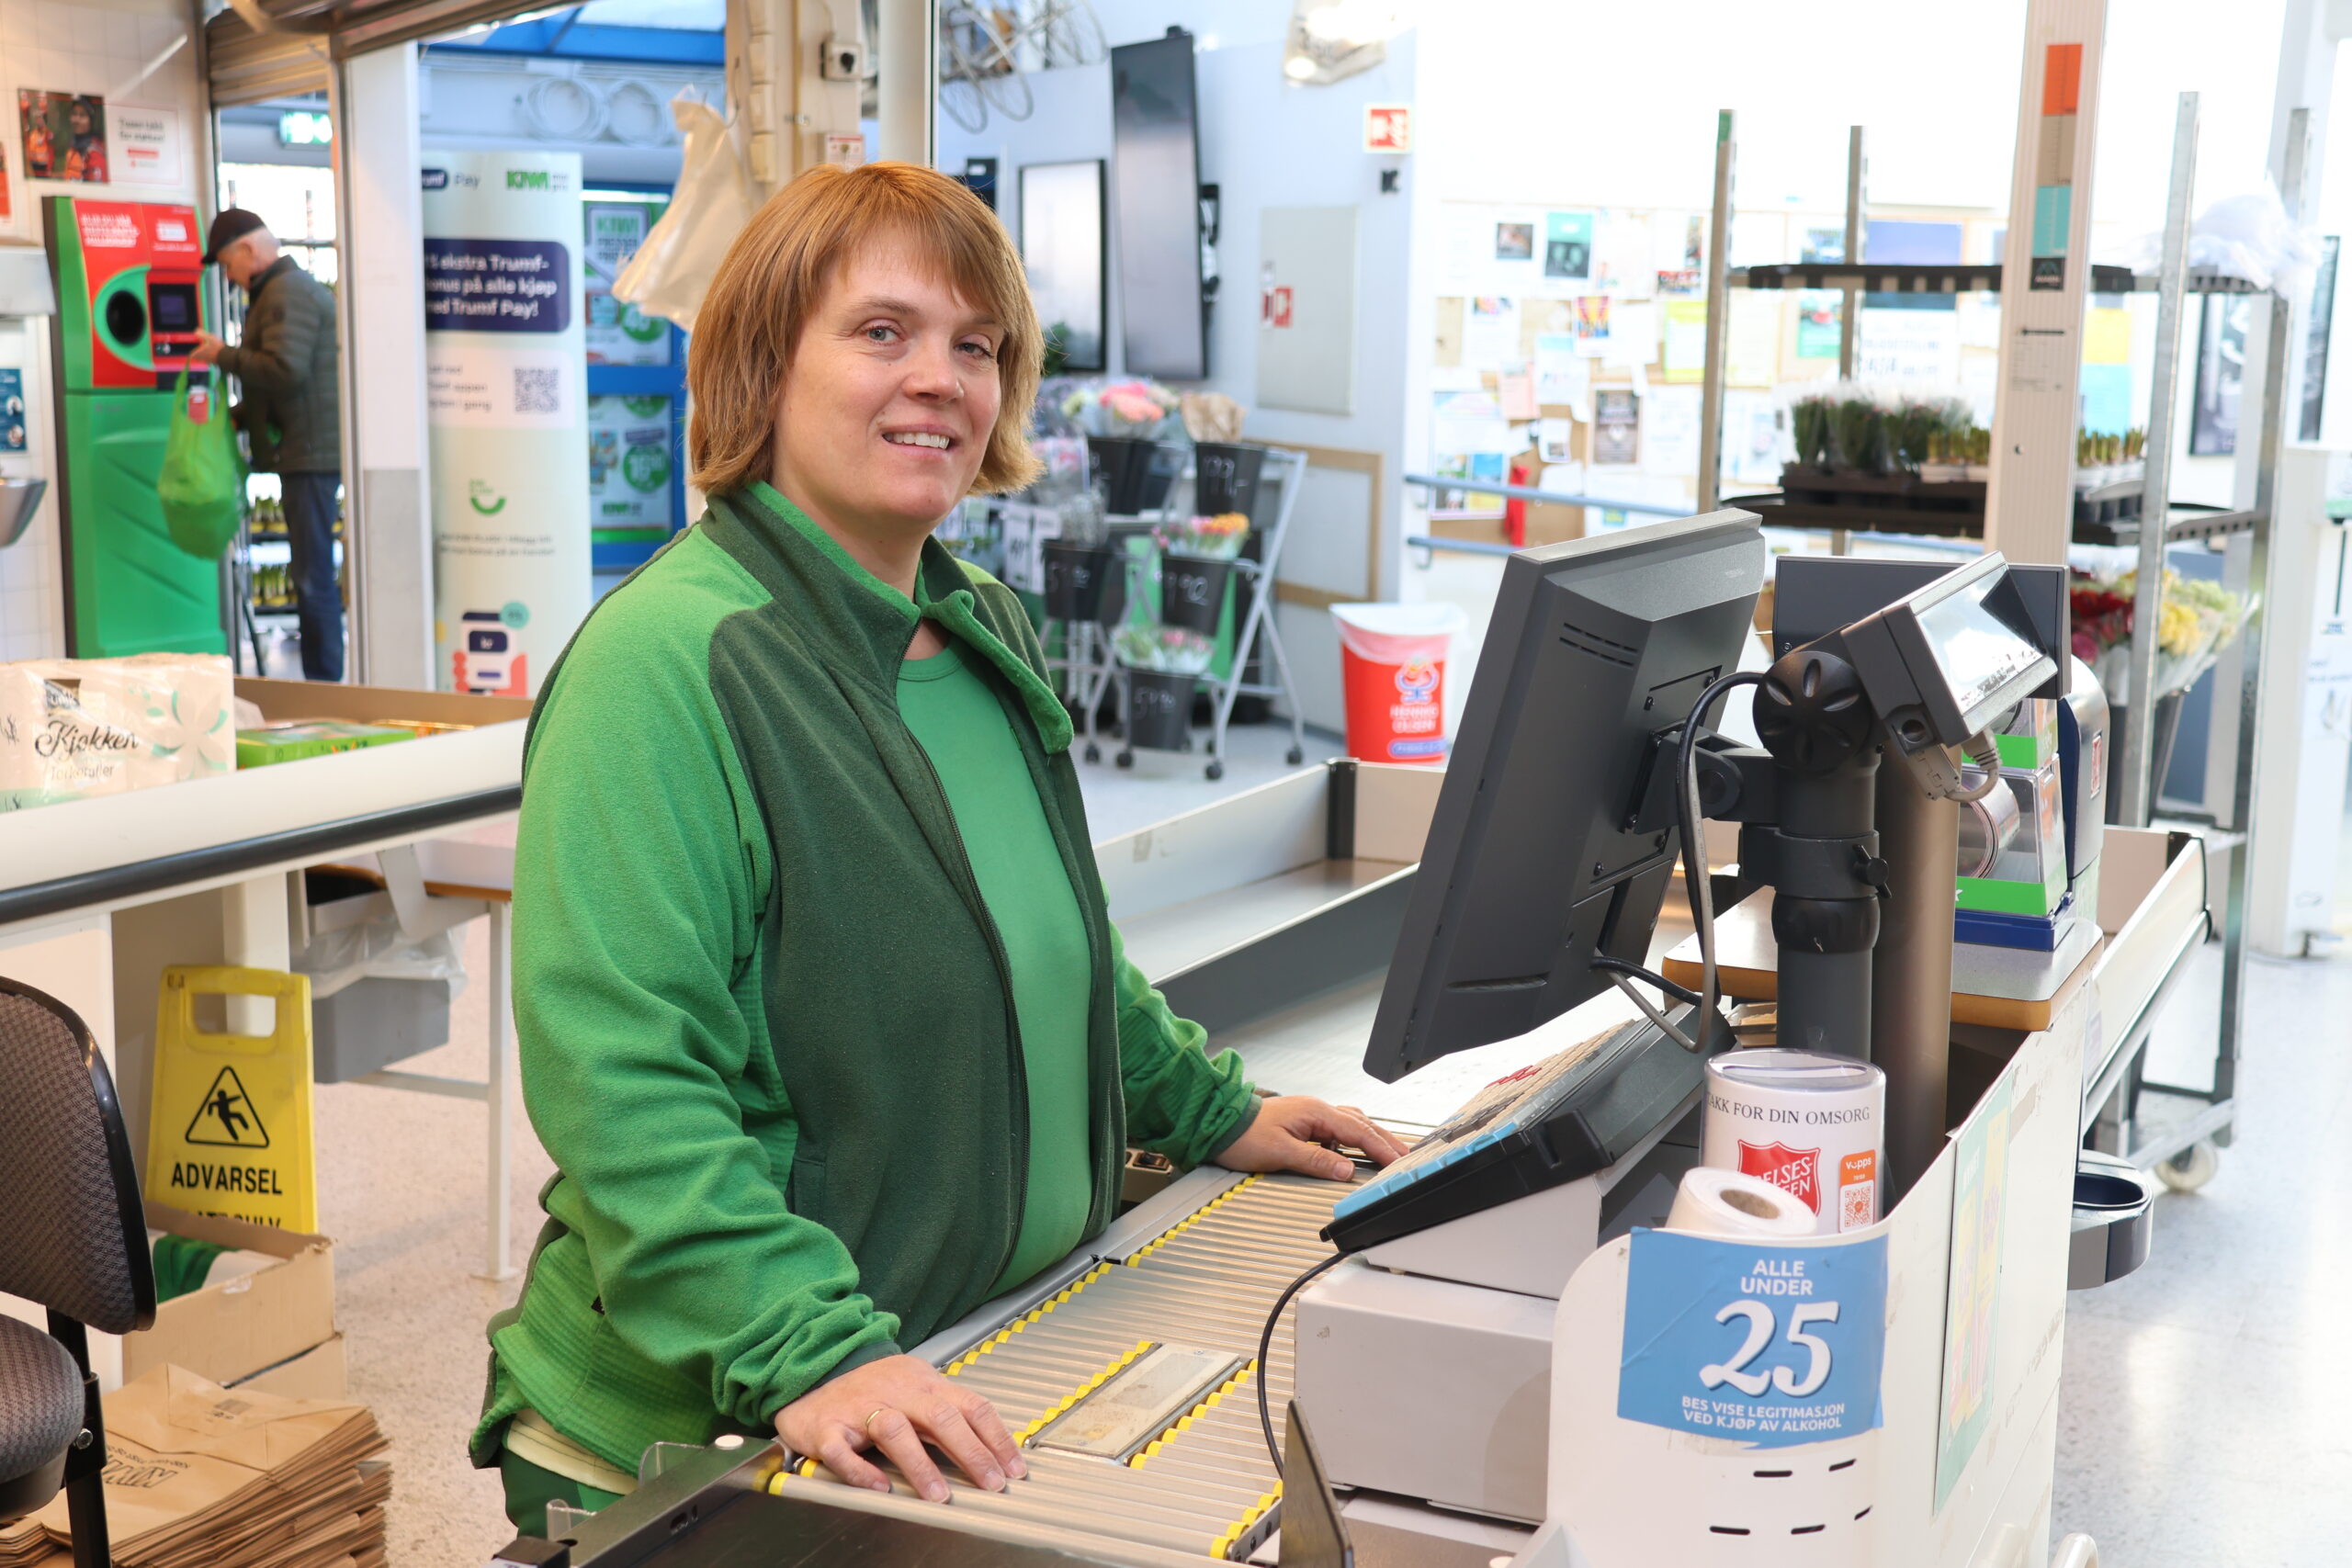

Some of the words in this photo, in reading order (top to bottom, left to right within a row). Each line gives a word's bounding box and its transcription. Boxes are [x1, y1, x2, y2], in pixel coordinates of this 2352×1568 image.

[506, 170, 548, 189] KIWI
[441, 253, 487, 270] ekstra
[462, 274, 482, 296] på
[485, 277, 516, 294] alle
[518, 276, 557, 298] kjøp
[452, 299, 498, 315] Trumf
[1733, 1101, 1763, 1121] FOR
[1770, 1109, 1800, 1124] DIN
[1805, 1106, 1871, 1124] OMSORG
[171, 1162, 283, 1195] ADVARSEL
[1753, 1259, 1804, 1277] ALLE
[1741, 1277, 1813, 1295] UNDER
[1699, 1299, 1841, 1398] 25
[1682, 1396, 1708, 1411] BES
[1713, 1401, 1745, 1416] VISE
[1748, 1403, 1845, 1418] LEGITIMASJON
[1683, 1409, 1713, 1425] VED
[1717, 1416, 1756, 1430] KJØP
[1758, 1420, 1779, 1431] AV
[1782, 1416, 1842, 1431] ALKOHOL
